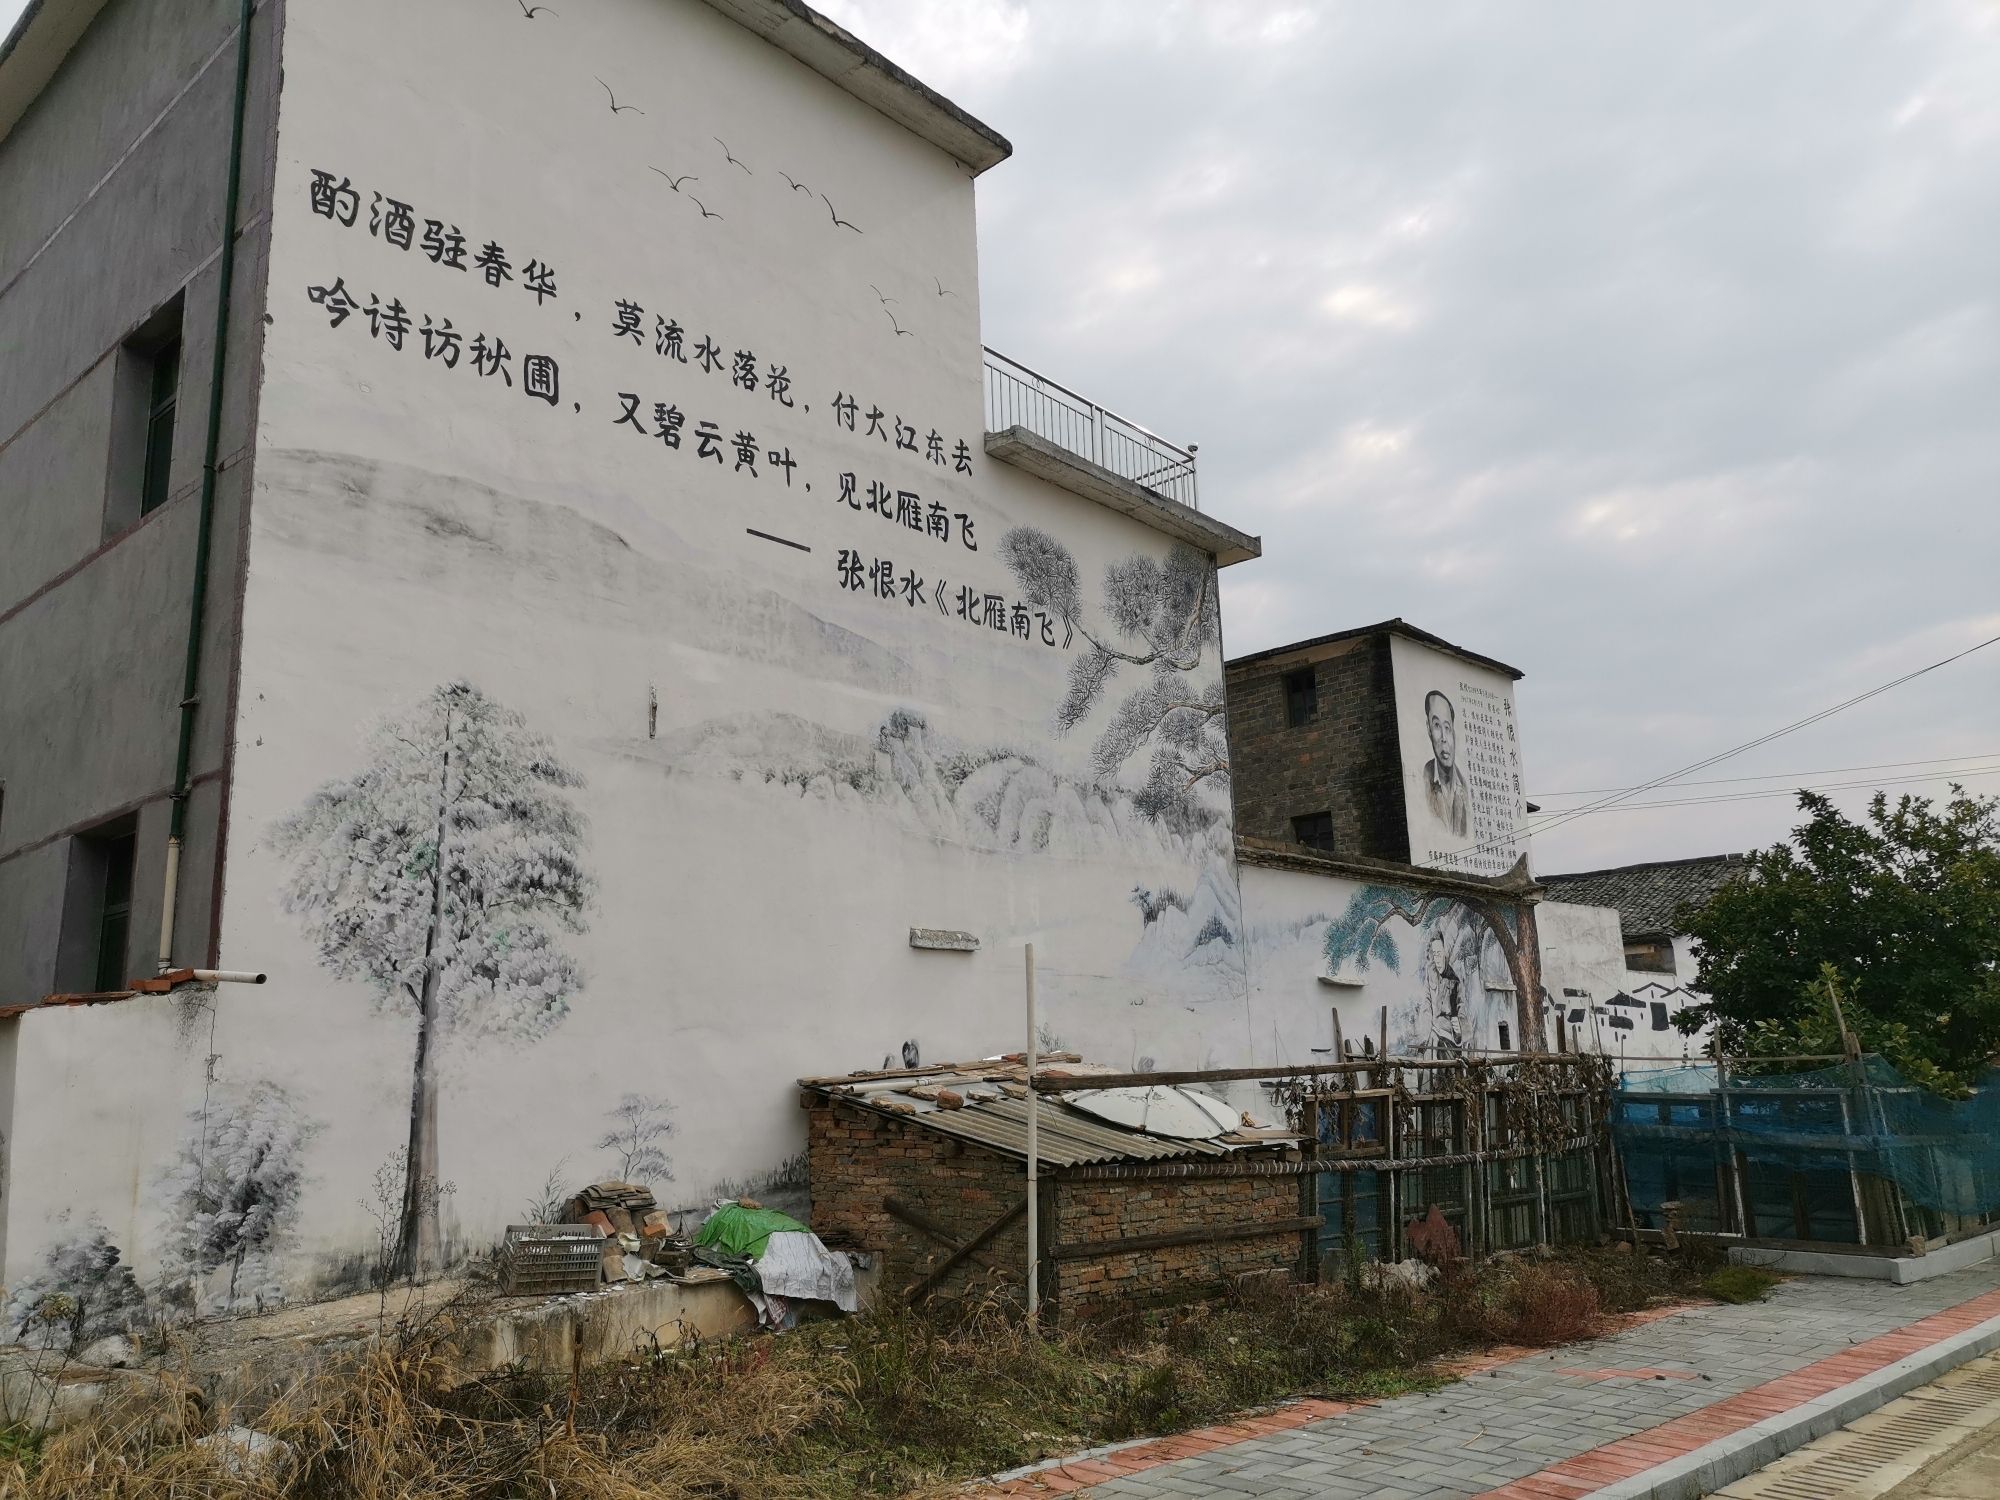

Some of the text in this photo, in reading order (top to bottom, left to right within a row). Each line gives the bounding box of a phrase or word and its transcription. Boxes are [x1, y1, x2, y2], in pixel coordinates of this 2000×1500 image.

[1503, 698, 1522, 820] 张恨水简介
